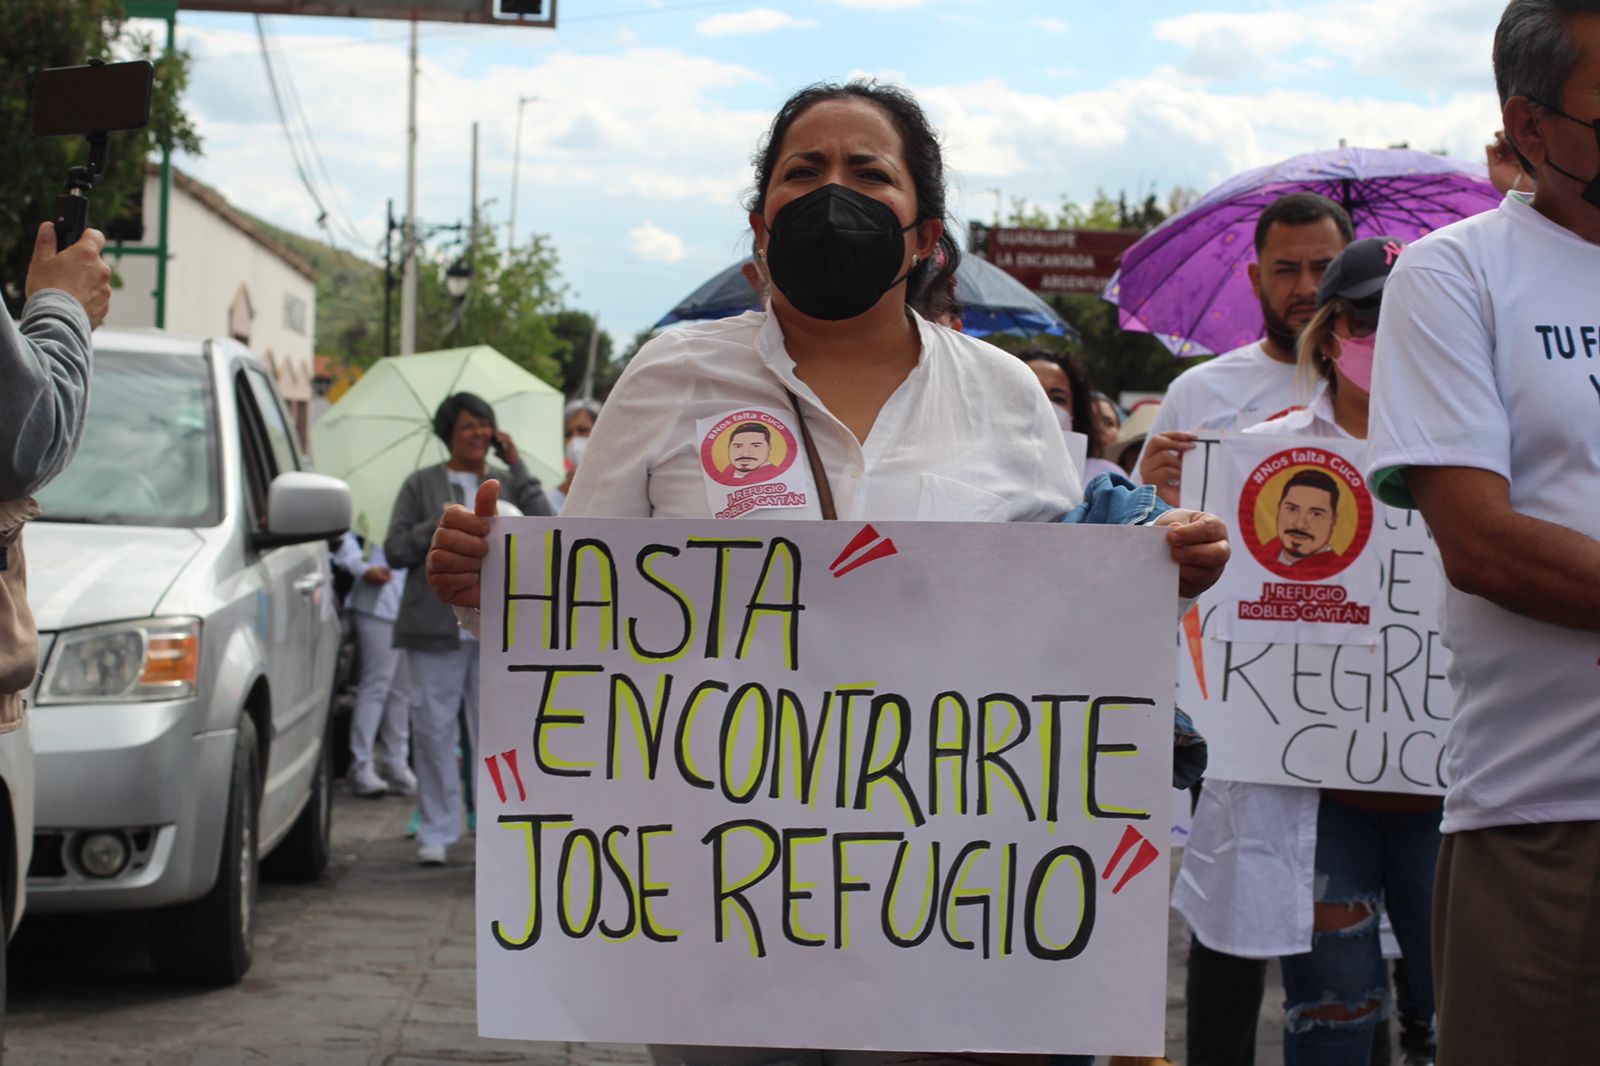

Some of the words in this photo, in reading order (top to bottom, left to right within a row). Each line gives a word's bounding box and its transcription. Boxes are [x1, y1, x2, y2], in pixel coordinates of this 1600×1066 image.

[995, 253, 1013, 266] LA
[1535, 325, 1576, 360] TU
[1580, 326, 1600, 358] F
[732, 412, 757, 422] falta
[760, 414, 785, 431] Cuco
[1254, 457, 1289, 484] #Nos
[1292, 450, 1326, 464] falta
[1329, 457, 1361, 487] Cuco
[502, 529, 806, 671] HASTA
[1240, 604, 1298, 619] ROBLES
[507, 664, 1156, 830] ENCONTRARTE
[491, 814, 684, 950] JOSE
[700, 818, 1097, 961] REFUGIO
